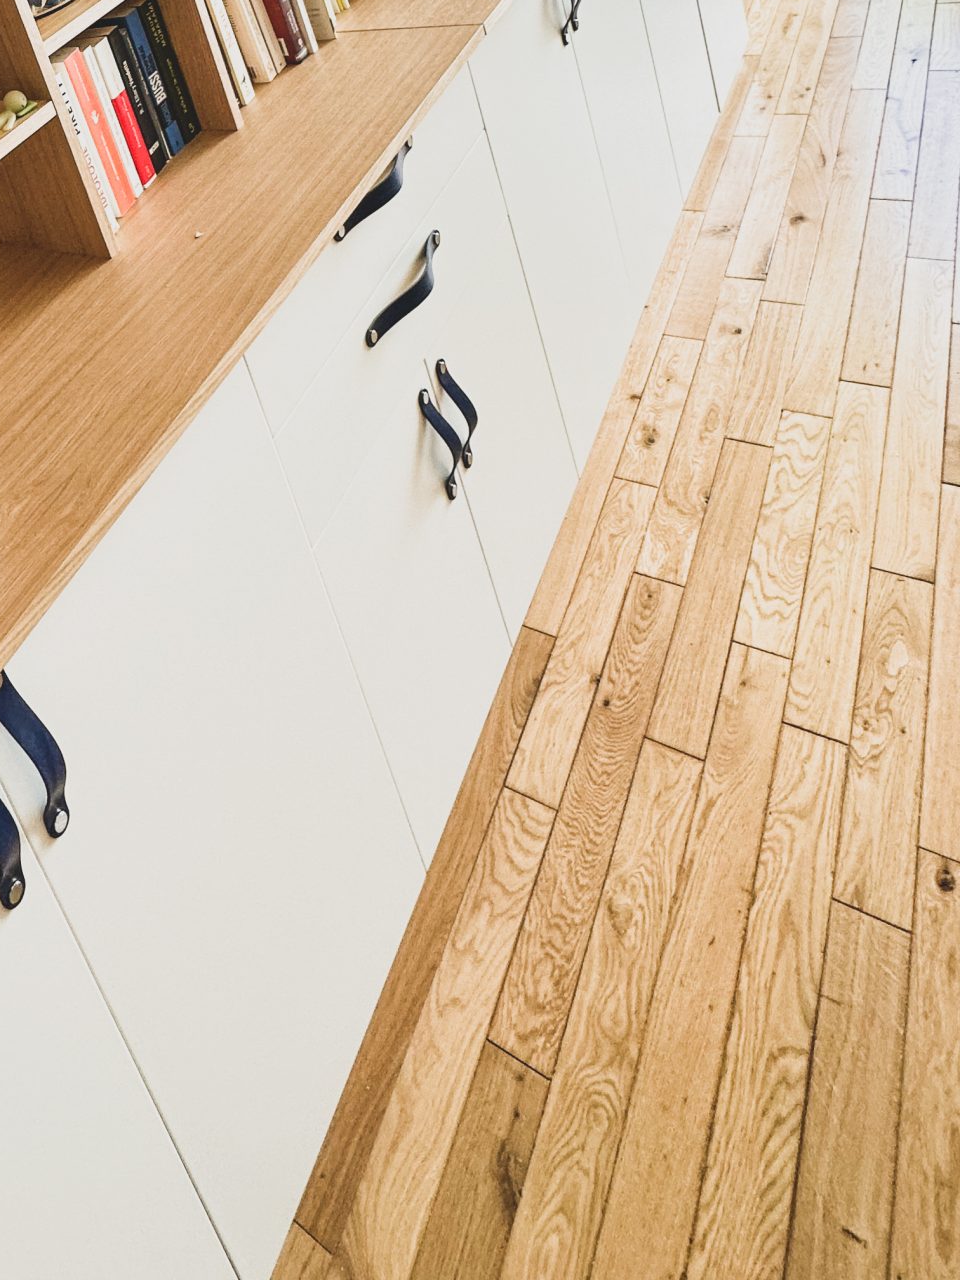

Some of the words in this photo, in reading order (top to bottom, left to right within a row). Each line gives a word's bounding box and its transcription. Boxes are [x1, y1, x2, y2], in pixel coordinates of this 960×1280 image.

[144, 1, 169, 47] MURAKAMI
[120, 60, 136, 85] Vendetta
[145, 69, 168, 104] BUSSI
